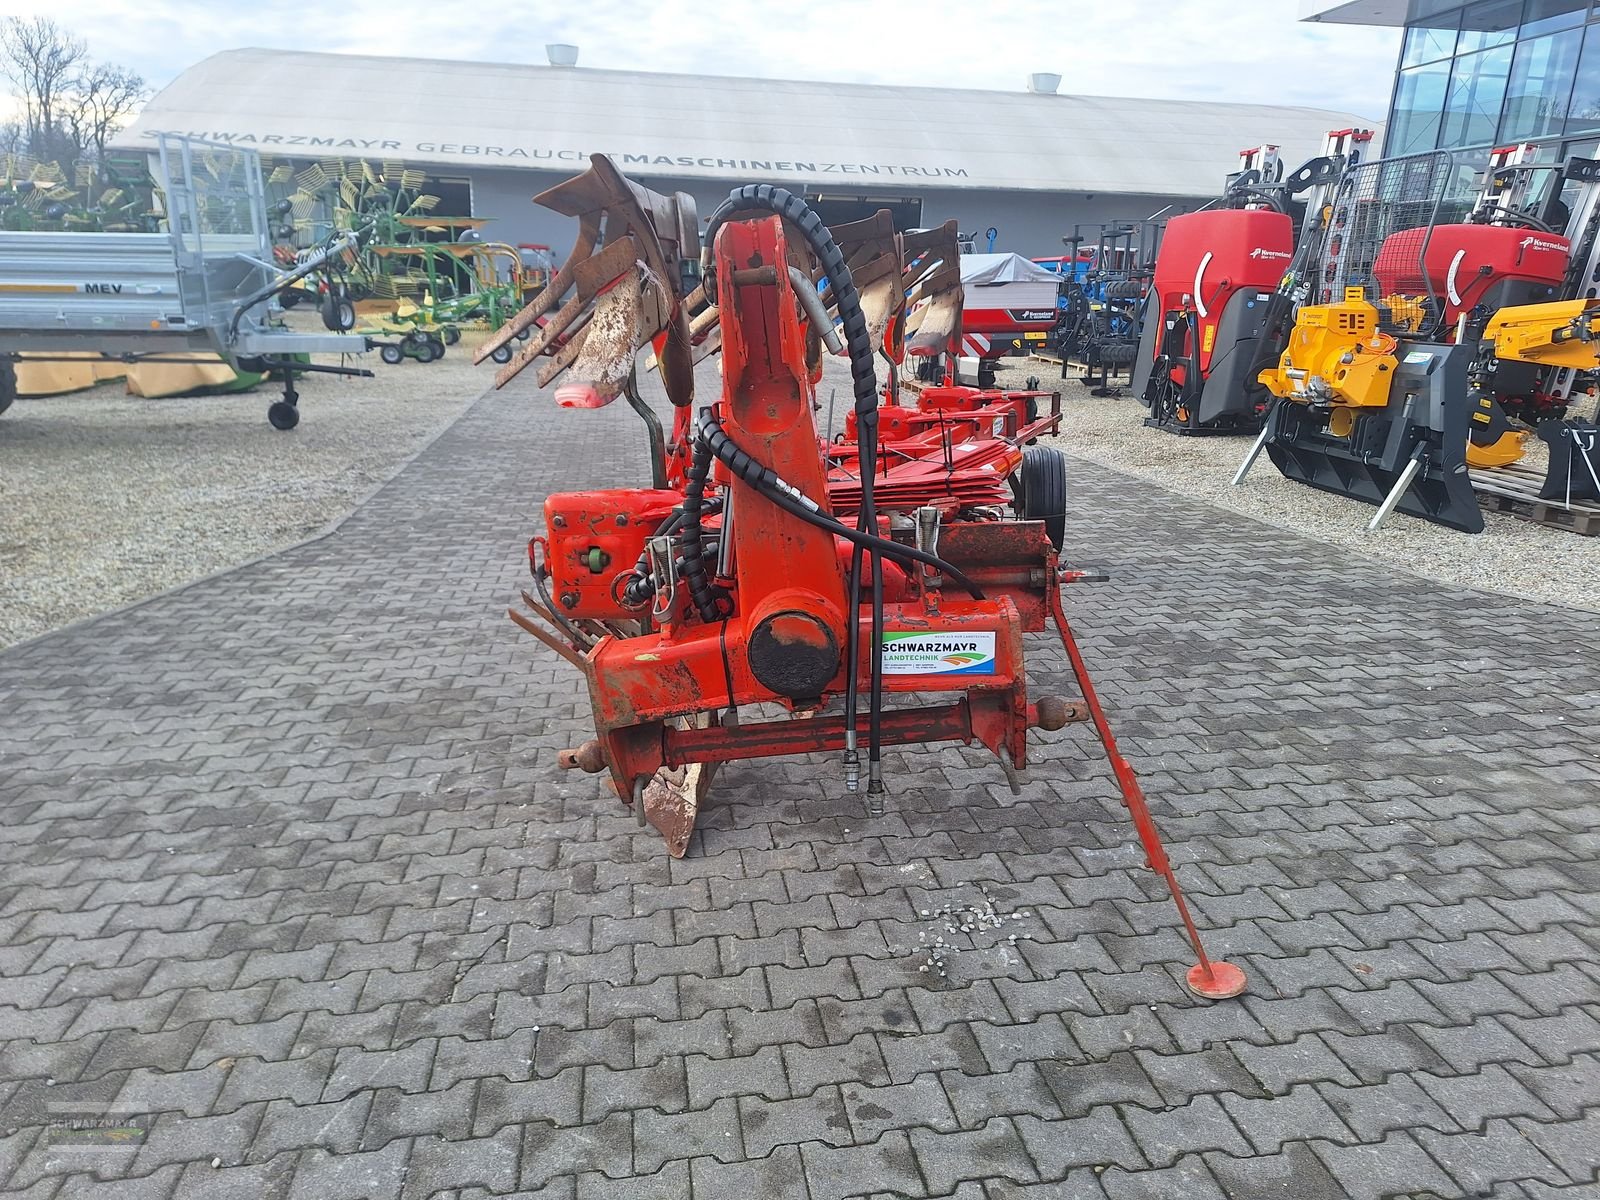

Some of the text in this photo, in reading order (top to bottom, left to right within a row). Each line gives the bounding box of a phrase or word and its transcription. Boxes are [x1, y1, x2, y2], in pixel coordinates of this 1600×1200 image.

[1533, 239, 1569, 252] Kverneland
[1261, 249, 1292, 259] Kverneland
[85, 283, 122, 294] MEV
[882, 643, 977, 652] SCHWARZMAYR
